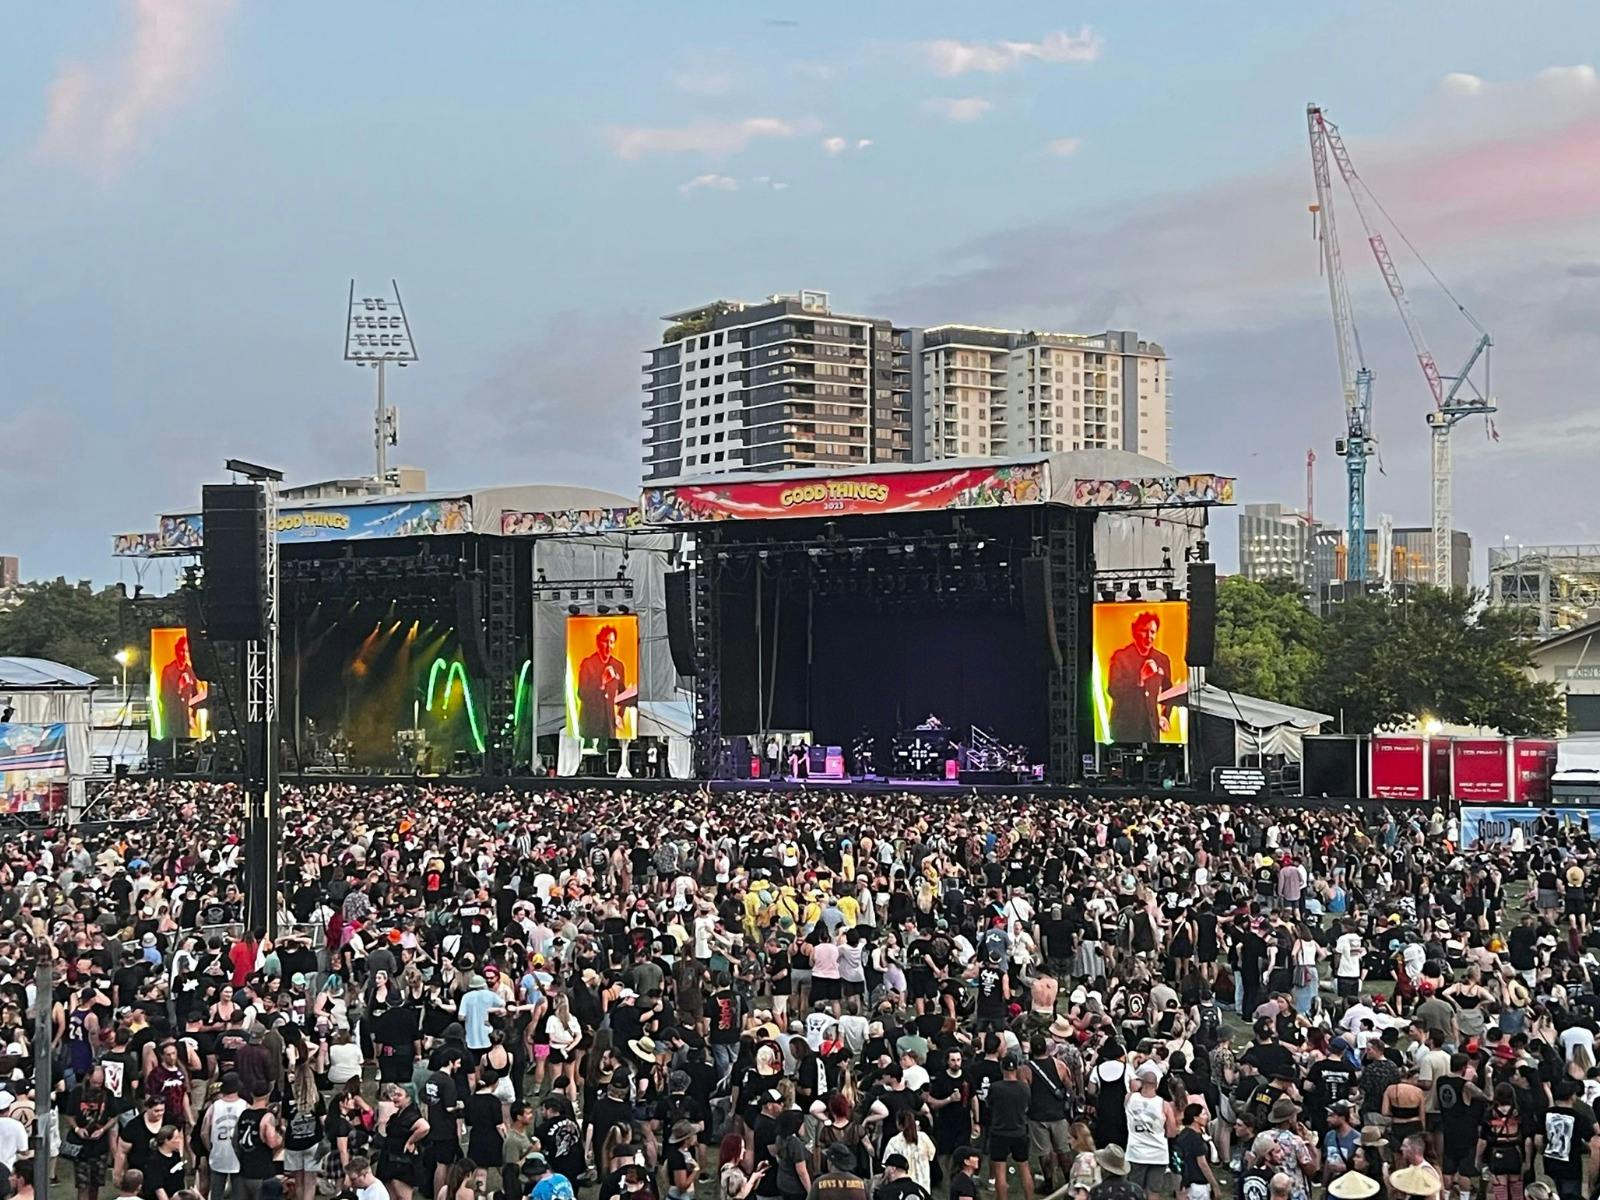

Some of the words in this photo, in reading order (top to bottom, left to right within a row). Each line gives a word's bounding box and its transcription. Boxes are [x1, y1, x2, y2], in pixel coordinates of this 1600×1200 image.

[782, 484, 828, 507] GOOD
[827, 480, 889, 502] THINGS
[823, 502, 845, 511] 2023
[303, 511, 349, 530] THINGS
[1478, 818, 1506, 839] GOOD
[69, 1023, 83, 1041] 24
